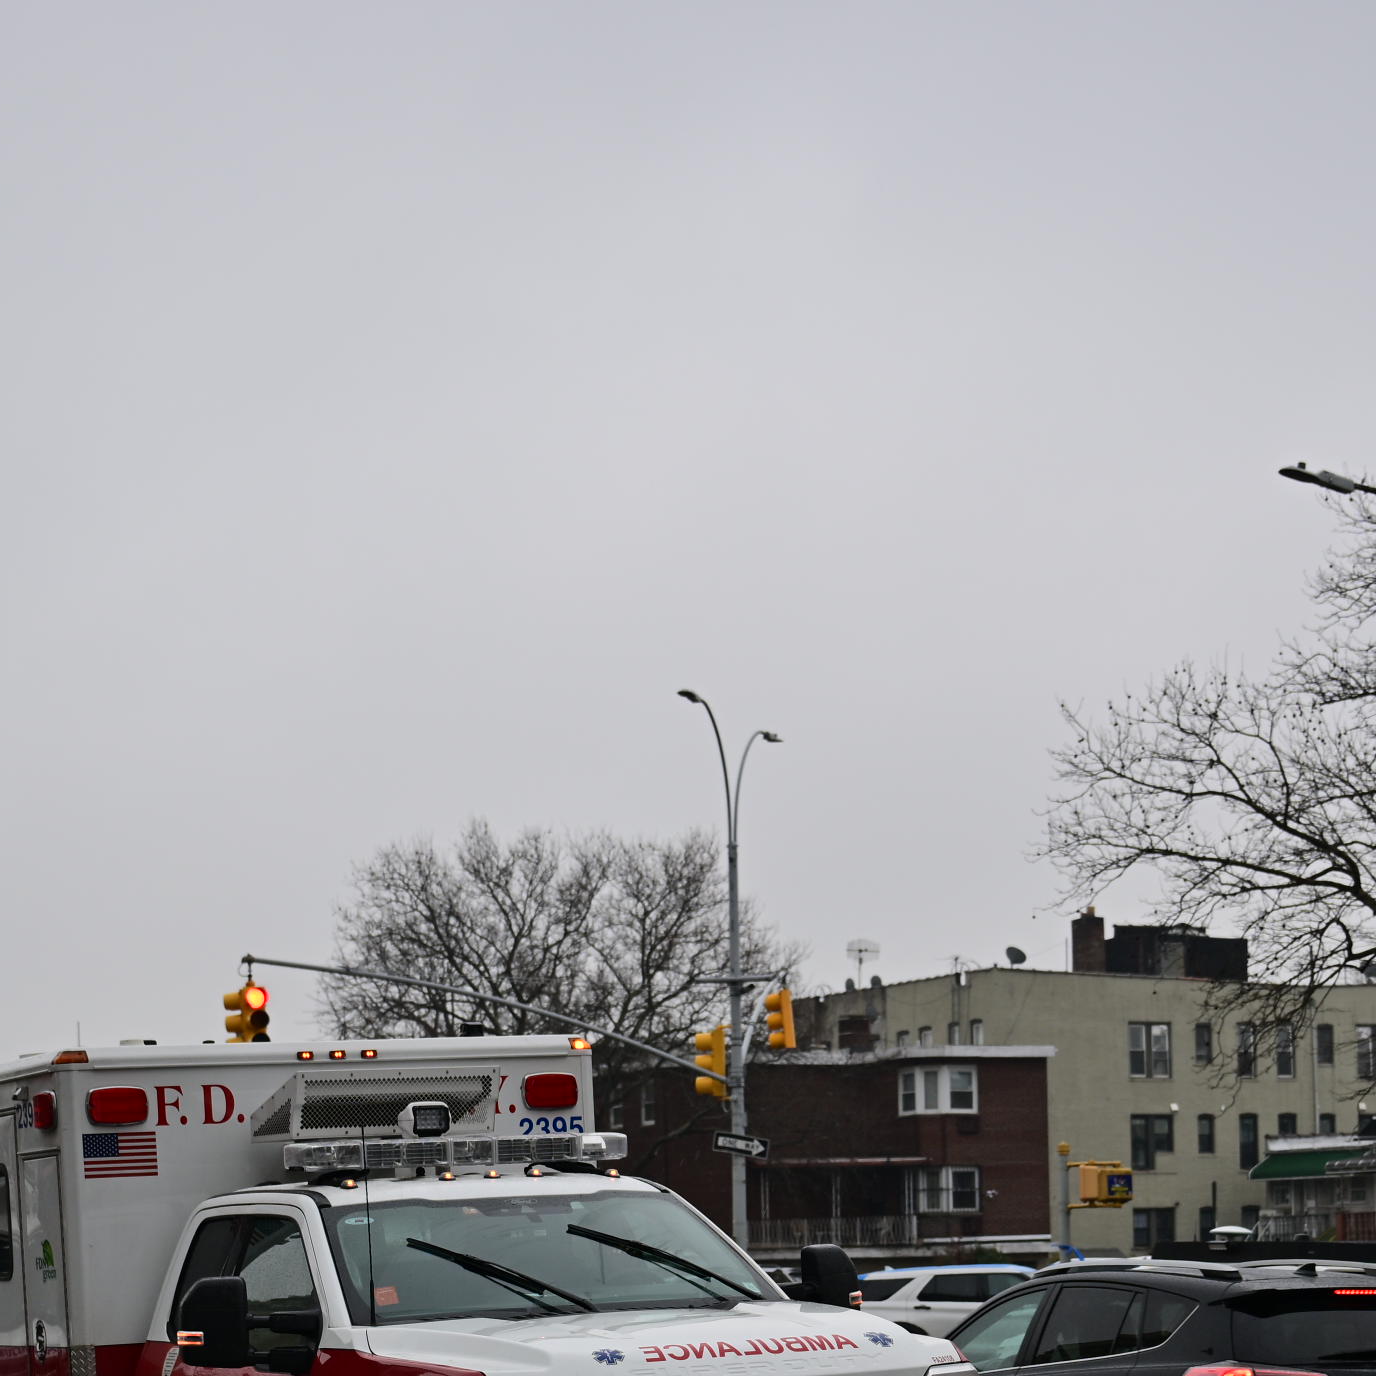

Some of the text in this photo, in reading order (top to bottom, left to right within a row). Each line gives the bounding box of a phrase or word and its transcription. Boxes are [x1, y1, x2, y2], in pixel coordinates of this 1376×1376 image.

[155, 1086, 188, 1126] F.
[201, 1084, 244, 1124] D.
[520, 1116, 584, 1135] 2395
